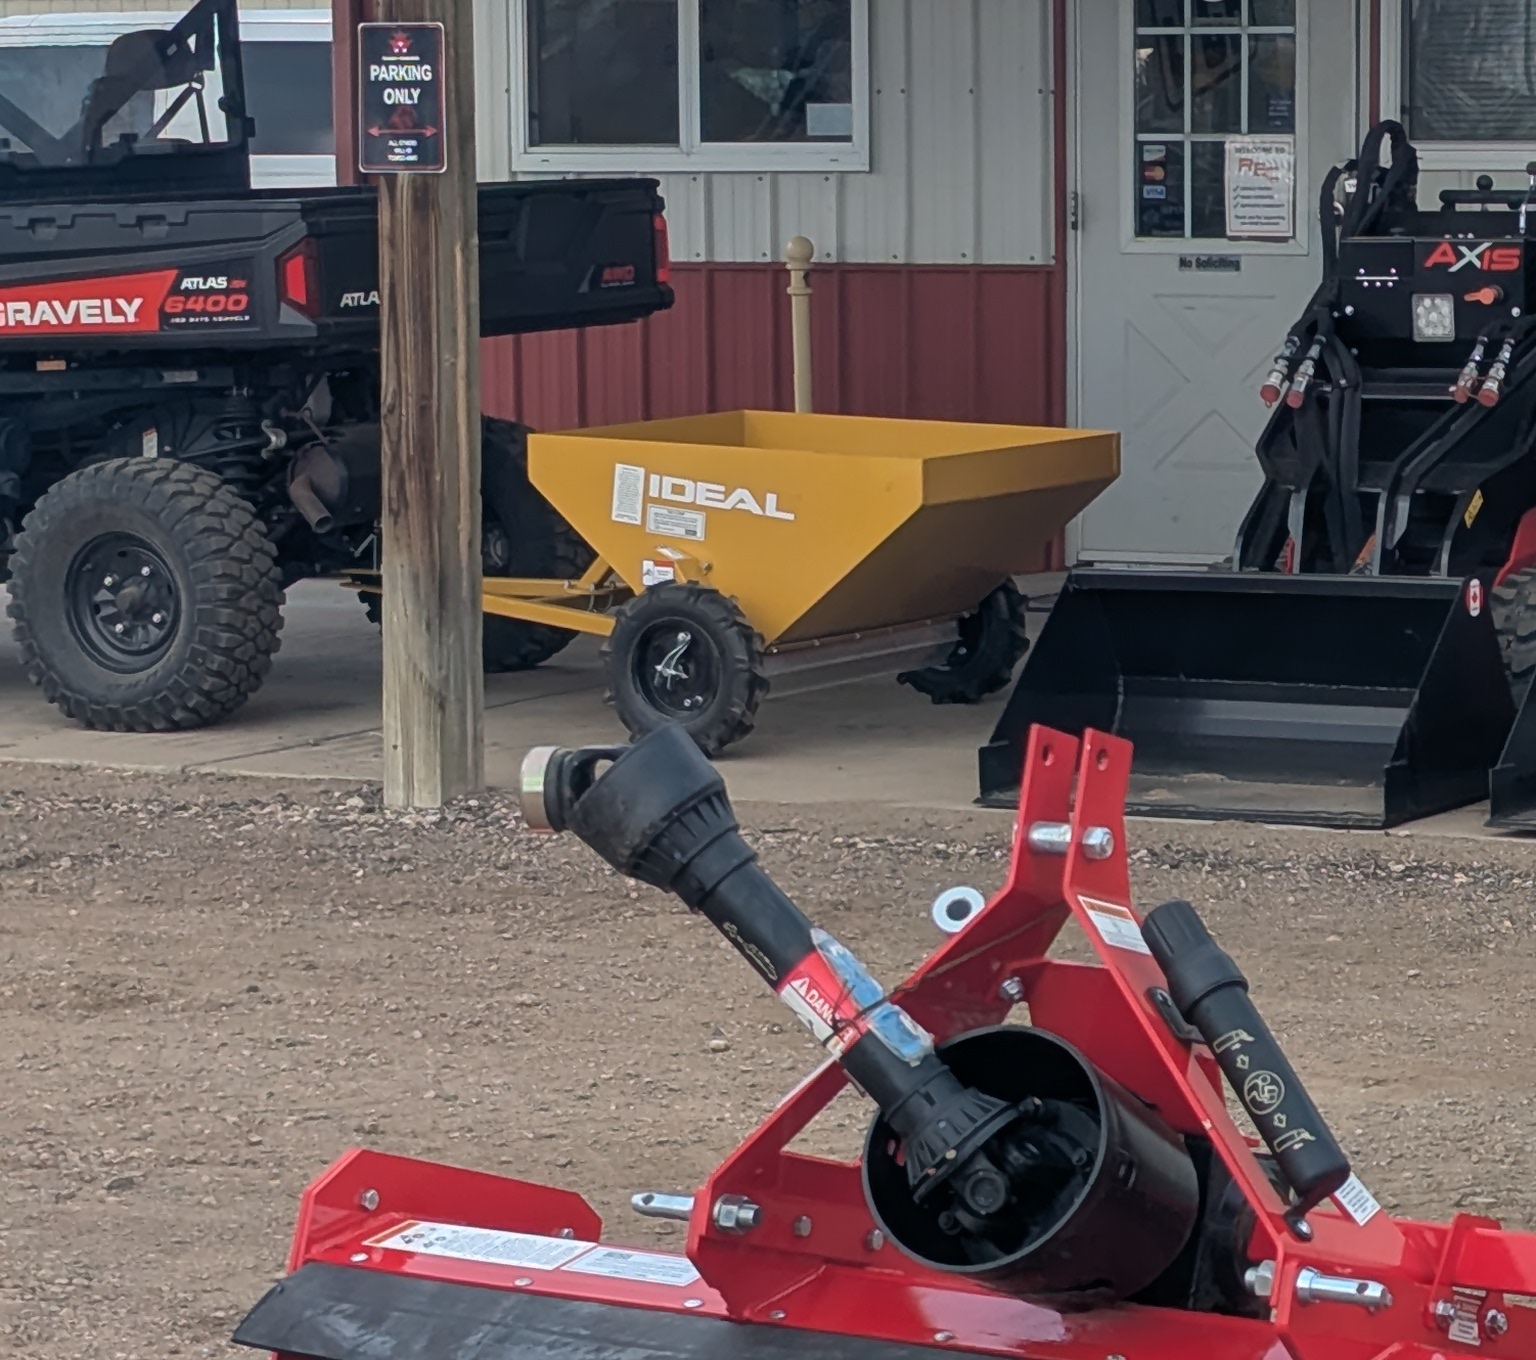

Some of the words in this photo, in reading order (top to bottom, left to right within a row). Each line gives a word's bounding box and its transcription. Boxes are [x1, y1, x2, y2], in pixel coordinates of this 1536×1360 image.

[369, 64, 433, 82] PARKING
[383, 88, 421, 105] ONLY
[1179, 257, 1192, 268] No
[1195, 256, 1240, 271] Soliciting
[1424, 241, 1522, 273] AXIS
[180, 276, 228, 291] ATLAS
[163, 294, 248, 314] 6400
[340, 290, 381, 308] ATLA
[0, 297, 143, 327] RAVELY
[649, 473, 795, 521] IDEAL
